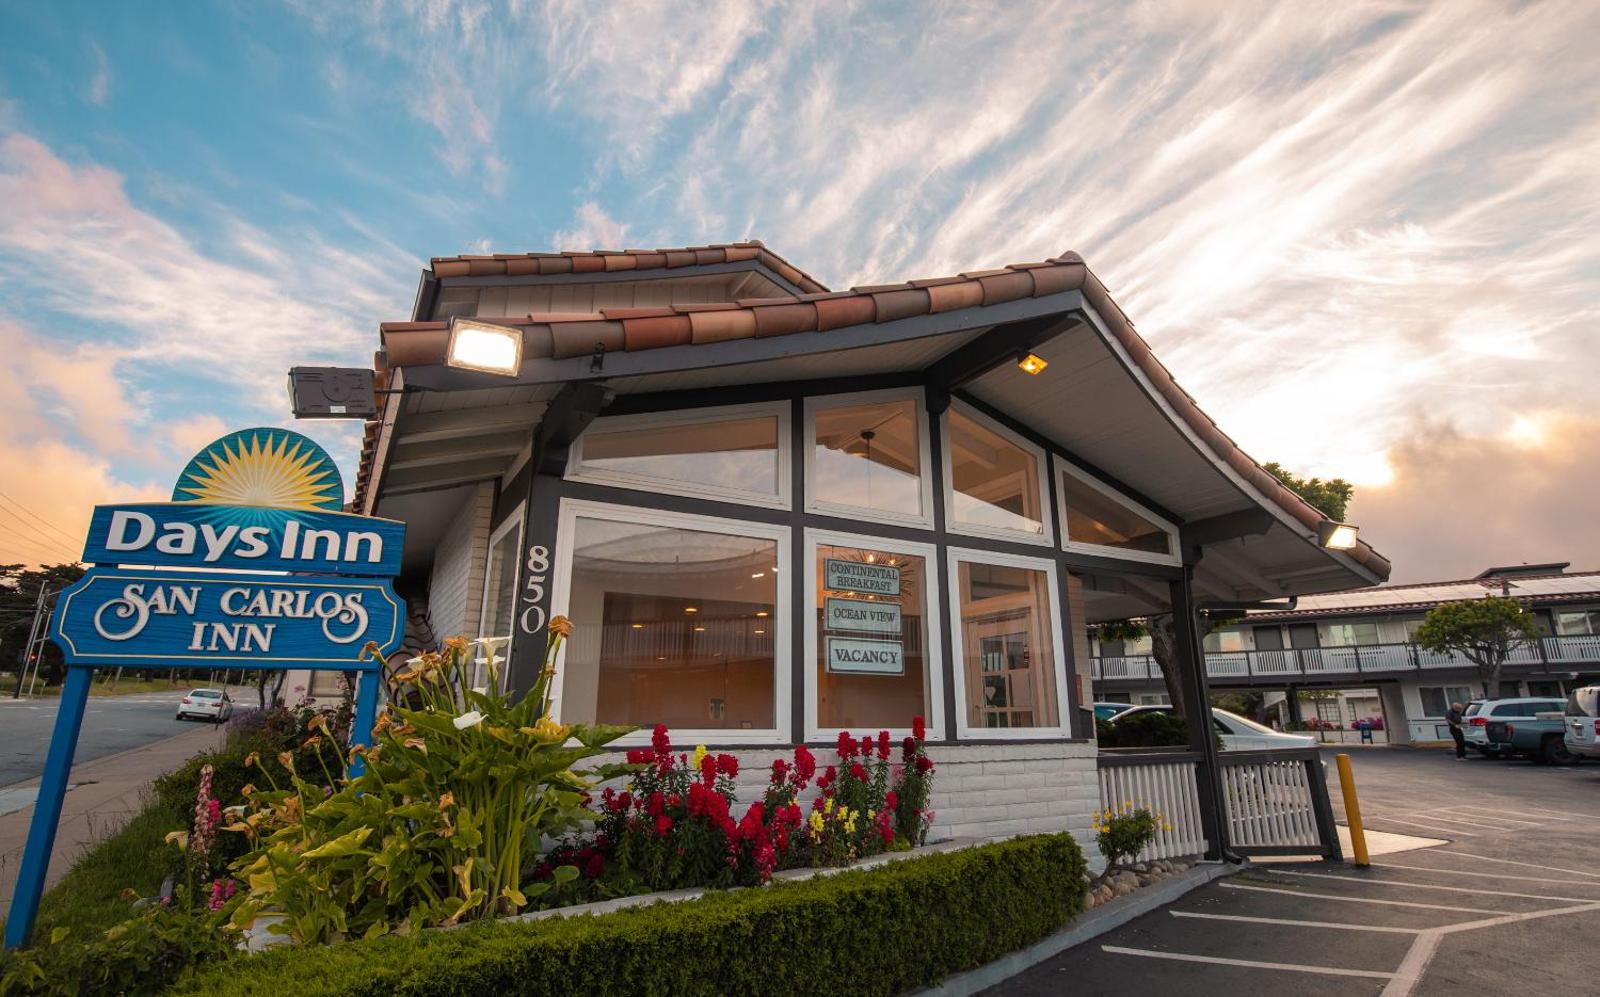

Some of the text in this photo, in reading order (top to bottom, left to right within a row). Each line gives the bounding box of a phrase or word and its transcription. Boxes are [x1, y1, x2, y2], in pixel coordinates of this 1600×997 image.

[106, 510, 383, 563] Days Inn
[830, 562, 898, 580] CONTINENTAL
[521, 545, 549, 634] 850
[837, 576, 892, 592] BREAKFAST
[94, 583, 369, 644] SAN CARLOS
[833, 607, 896, 623] OCEAN VIEW
[188, 622, 276, 653] INN
[835, 648, 898, 664] VACANCY
